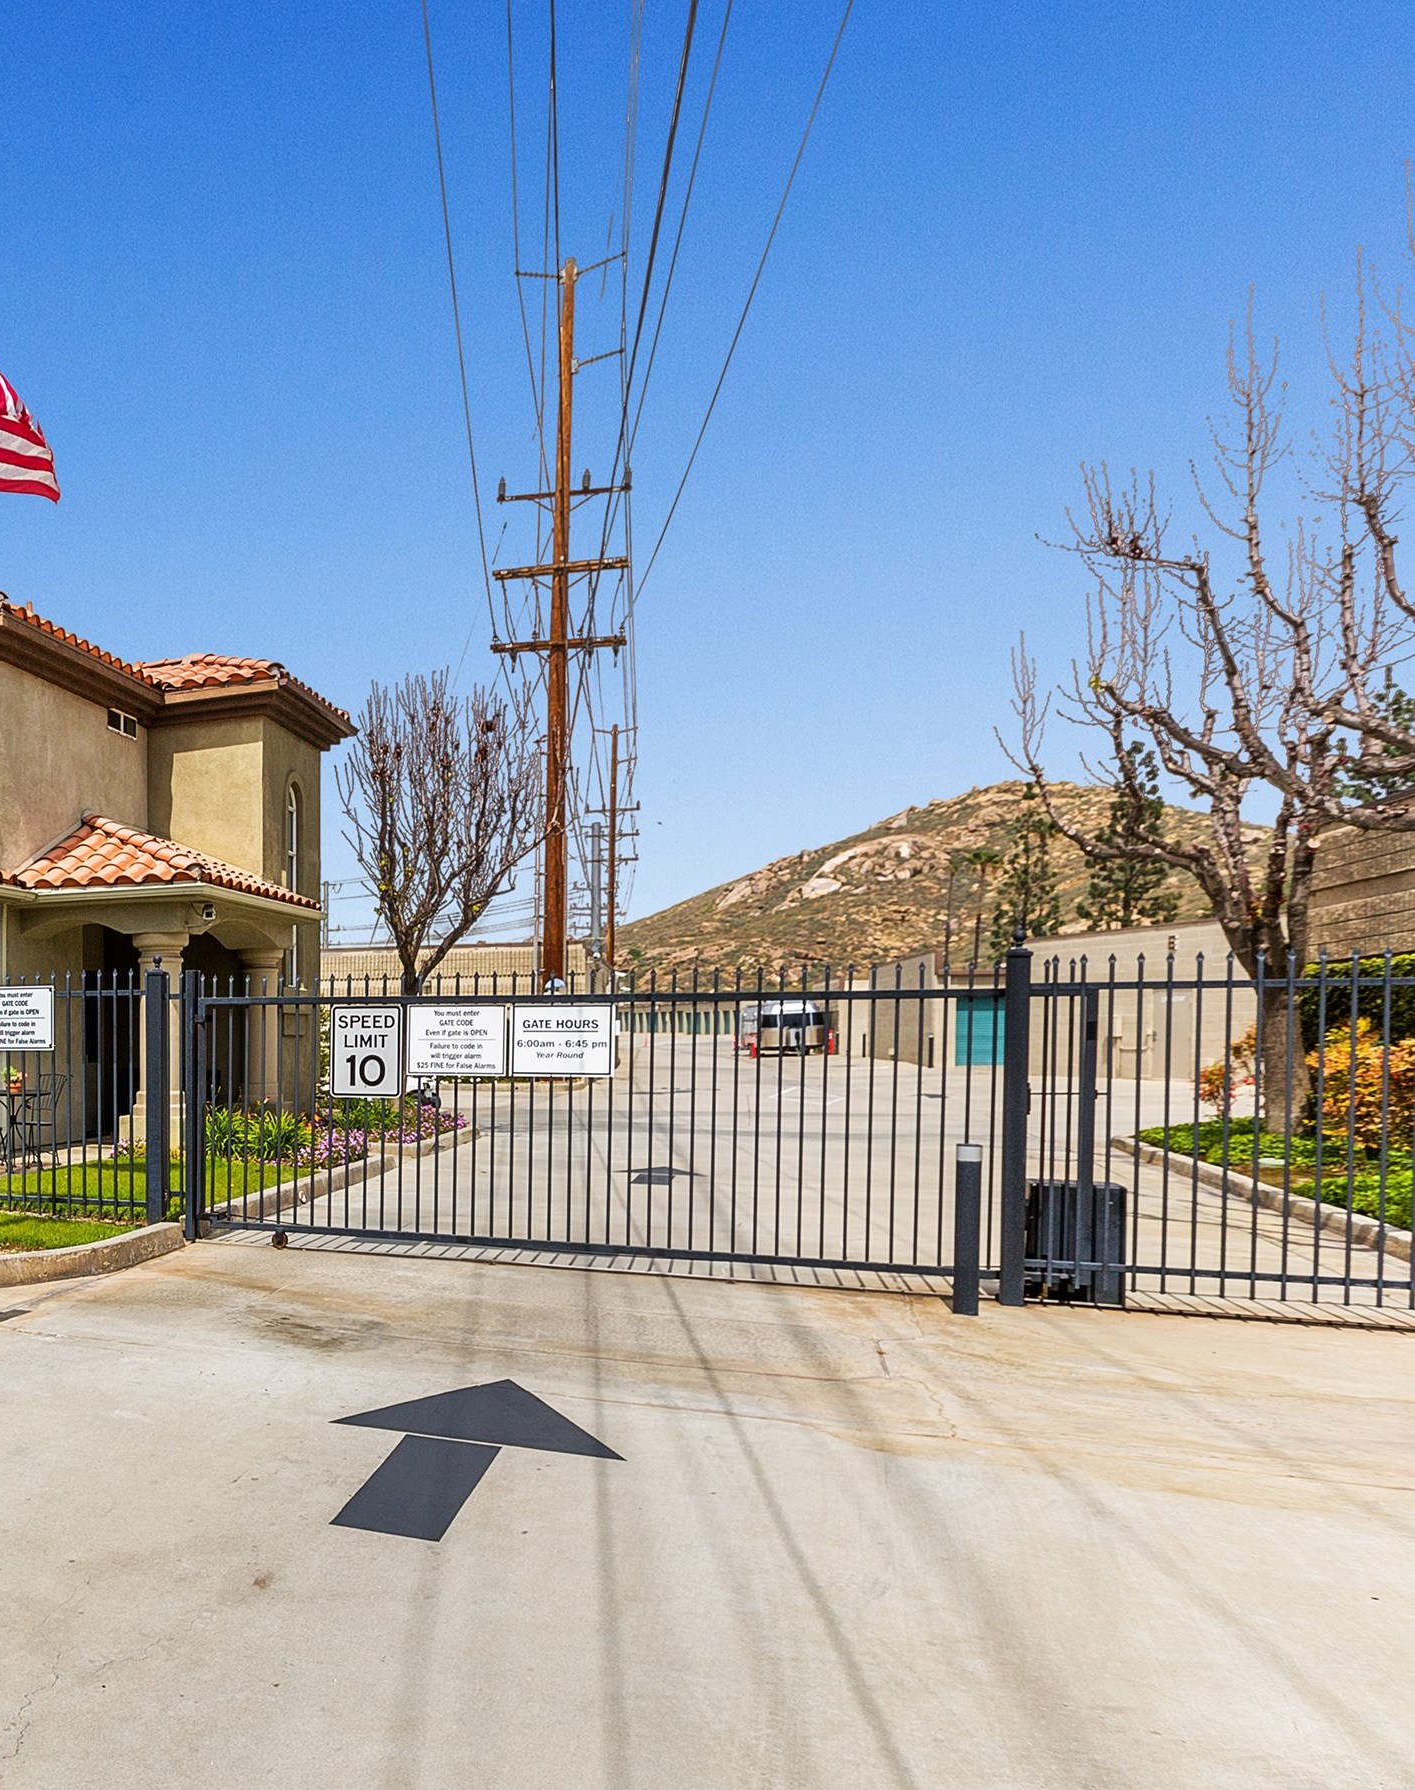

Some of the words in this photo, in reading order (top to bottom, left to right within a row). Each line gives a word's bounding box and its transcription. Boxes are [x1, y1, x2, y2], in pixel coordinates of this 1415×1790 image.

[338, 1015, 395, 1029] SPEED
[523, 1020, 552, 1028] GATE
[556, 1020, 599, 1029] HOURS
[344, 1034, 388, 1048] LIMIT
[517, 1040, 555, 1048] 6:00am
[565, 1040, 588, 1048] 6:45
[591, 1041, 607, 1049] pm
[346, 1054, 386, 1087] 10
